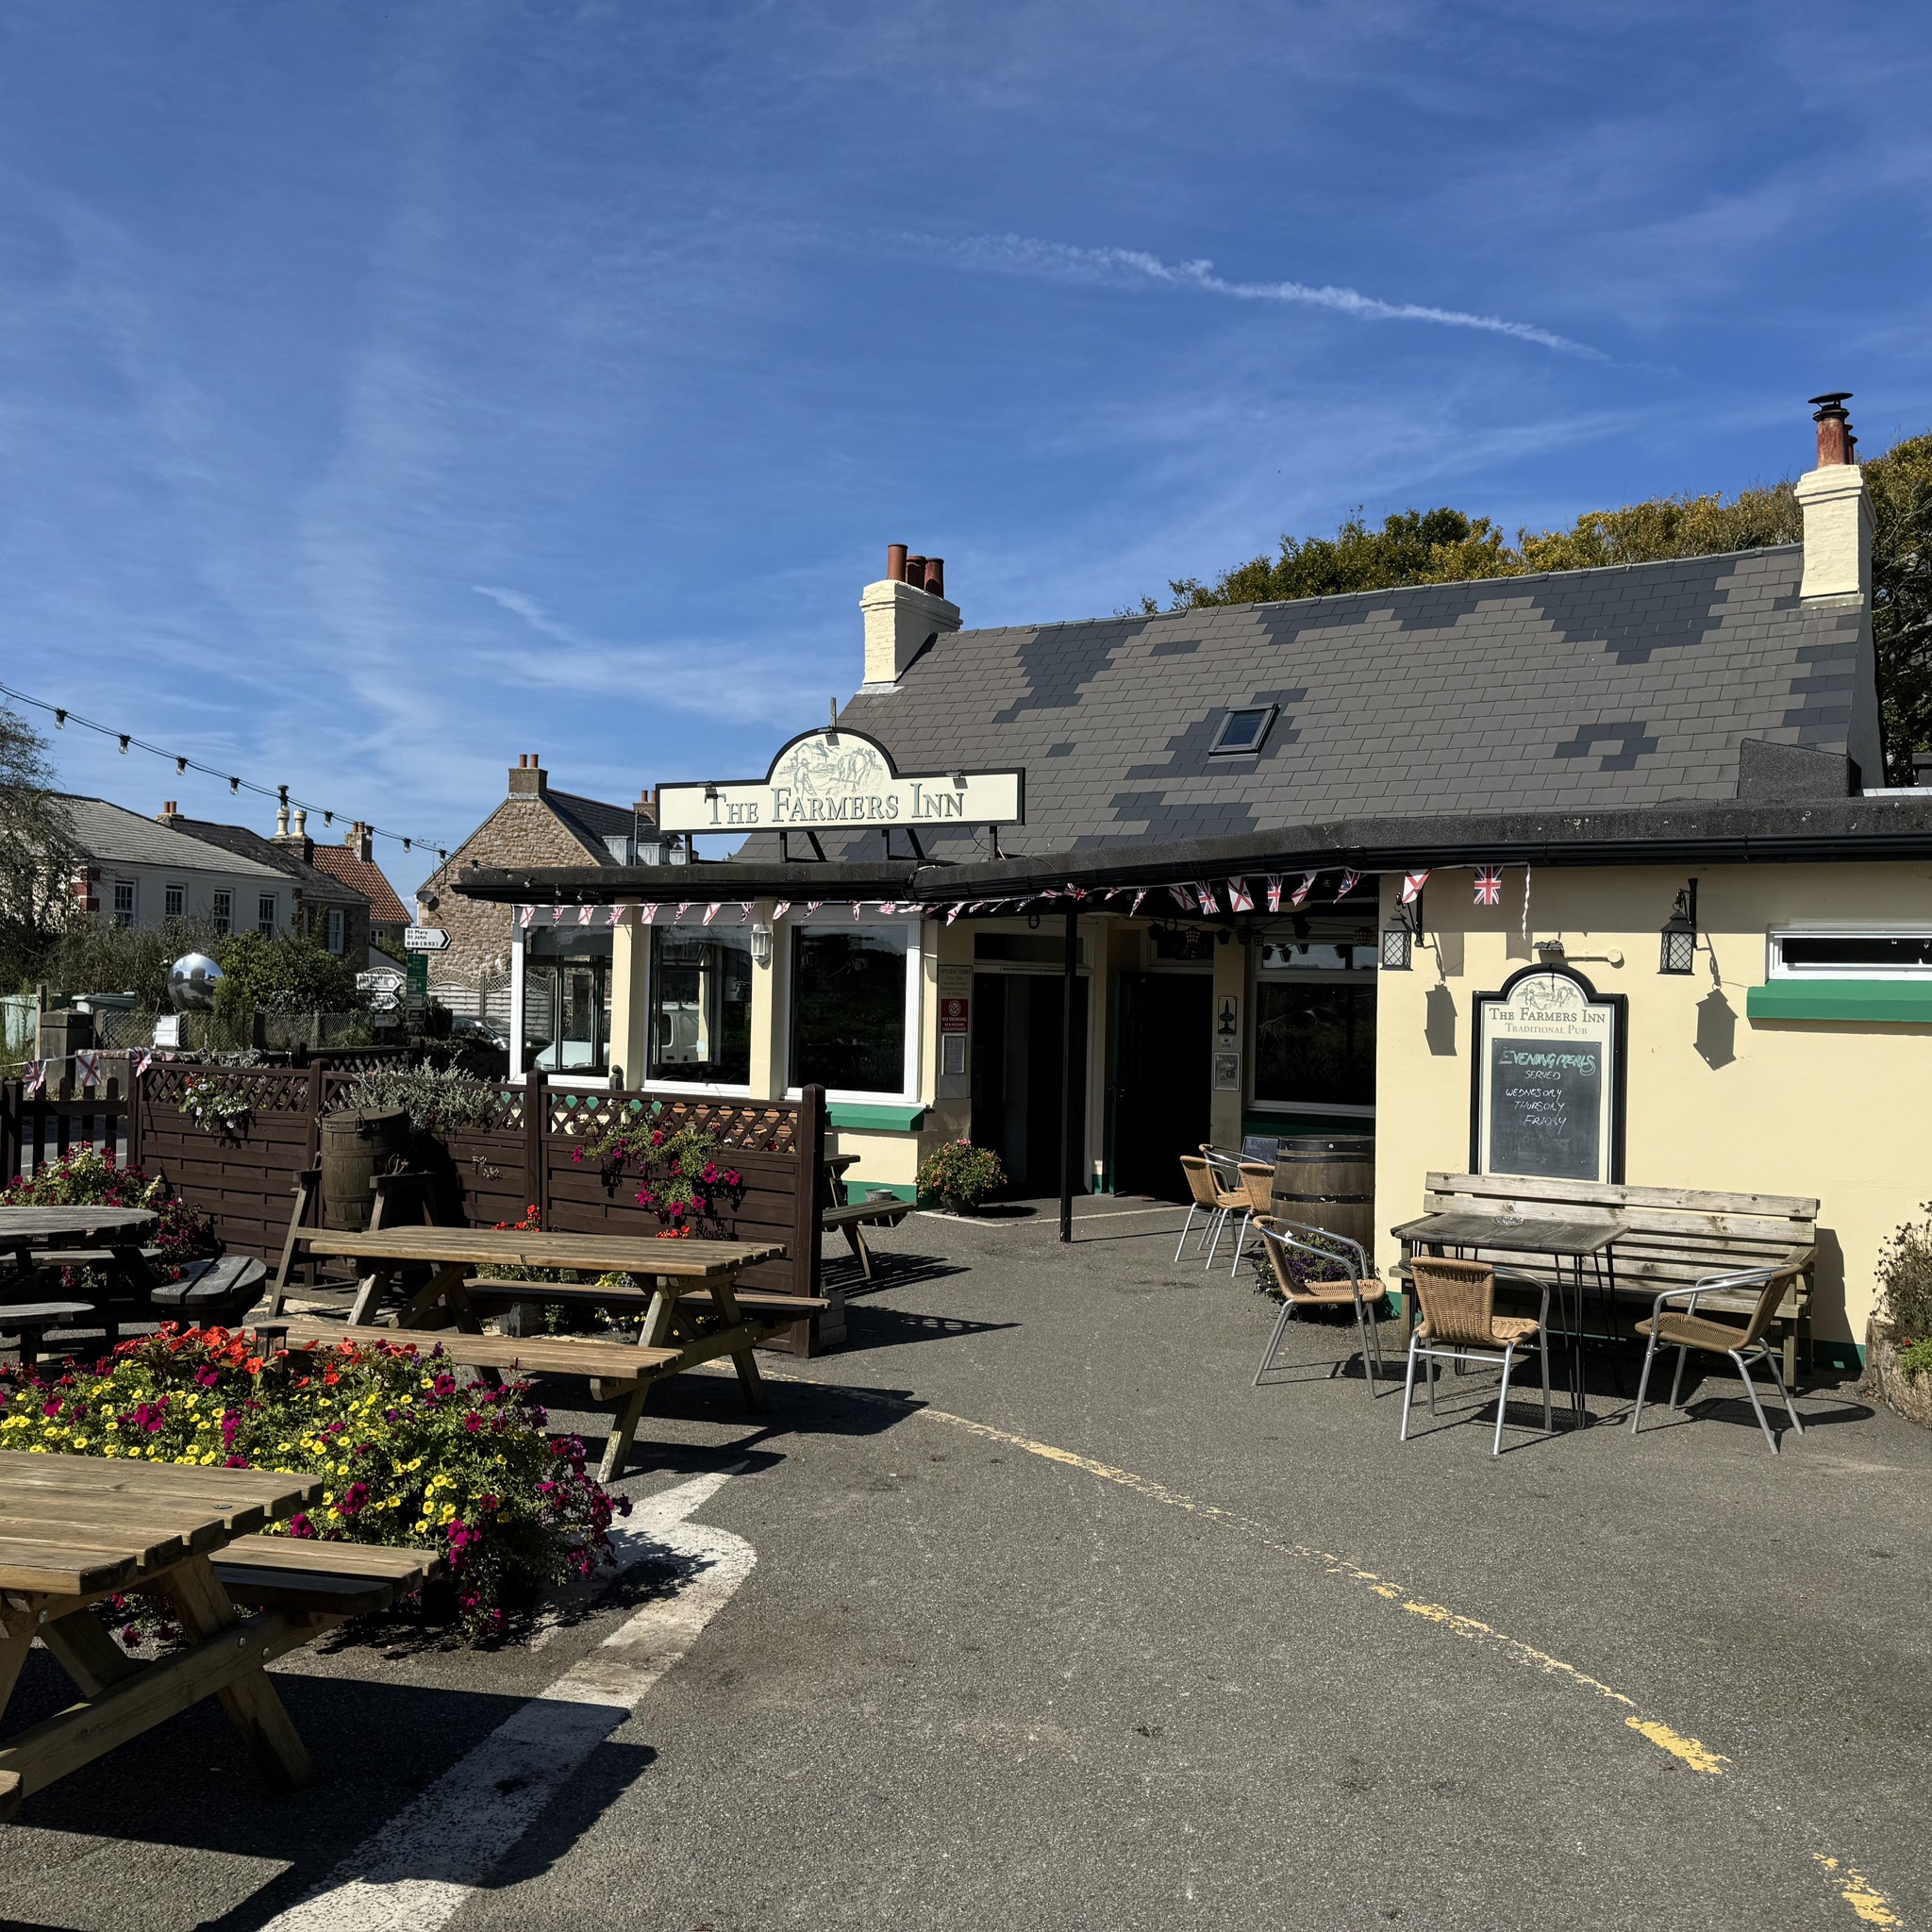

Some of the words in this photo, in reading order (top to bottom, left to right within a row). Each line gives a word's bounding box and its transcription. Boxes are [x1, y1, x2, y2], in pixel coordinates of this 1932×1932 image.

[705, 792, 759, 825] THE
[770, 786, 899, 823] FARMERS
[909, 782, 965, 819] INN
[1489, 1008, 1515, 1021] THE
[1520, 1007, 1577, 1023] FARMERS
[1581, 1008, 1606, 1024] INN
[1505, 1023, 1565, 1034] TRADITIONAL
[1568, 1024, 1588, 1035] PUB
[1497, 1049, 1557, 1069] EVENING
[1524, 1070, 1561, 1081] SERVED
[1505, 1088, 1562, 1104] WEDNESDAY
[1514, 1100, 1565, 1118] THURSDAY
[1523, 1114, 1568, 1135] FRIDAY
